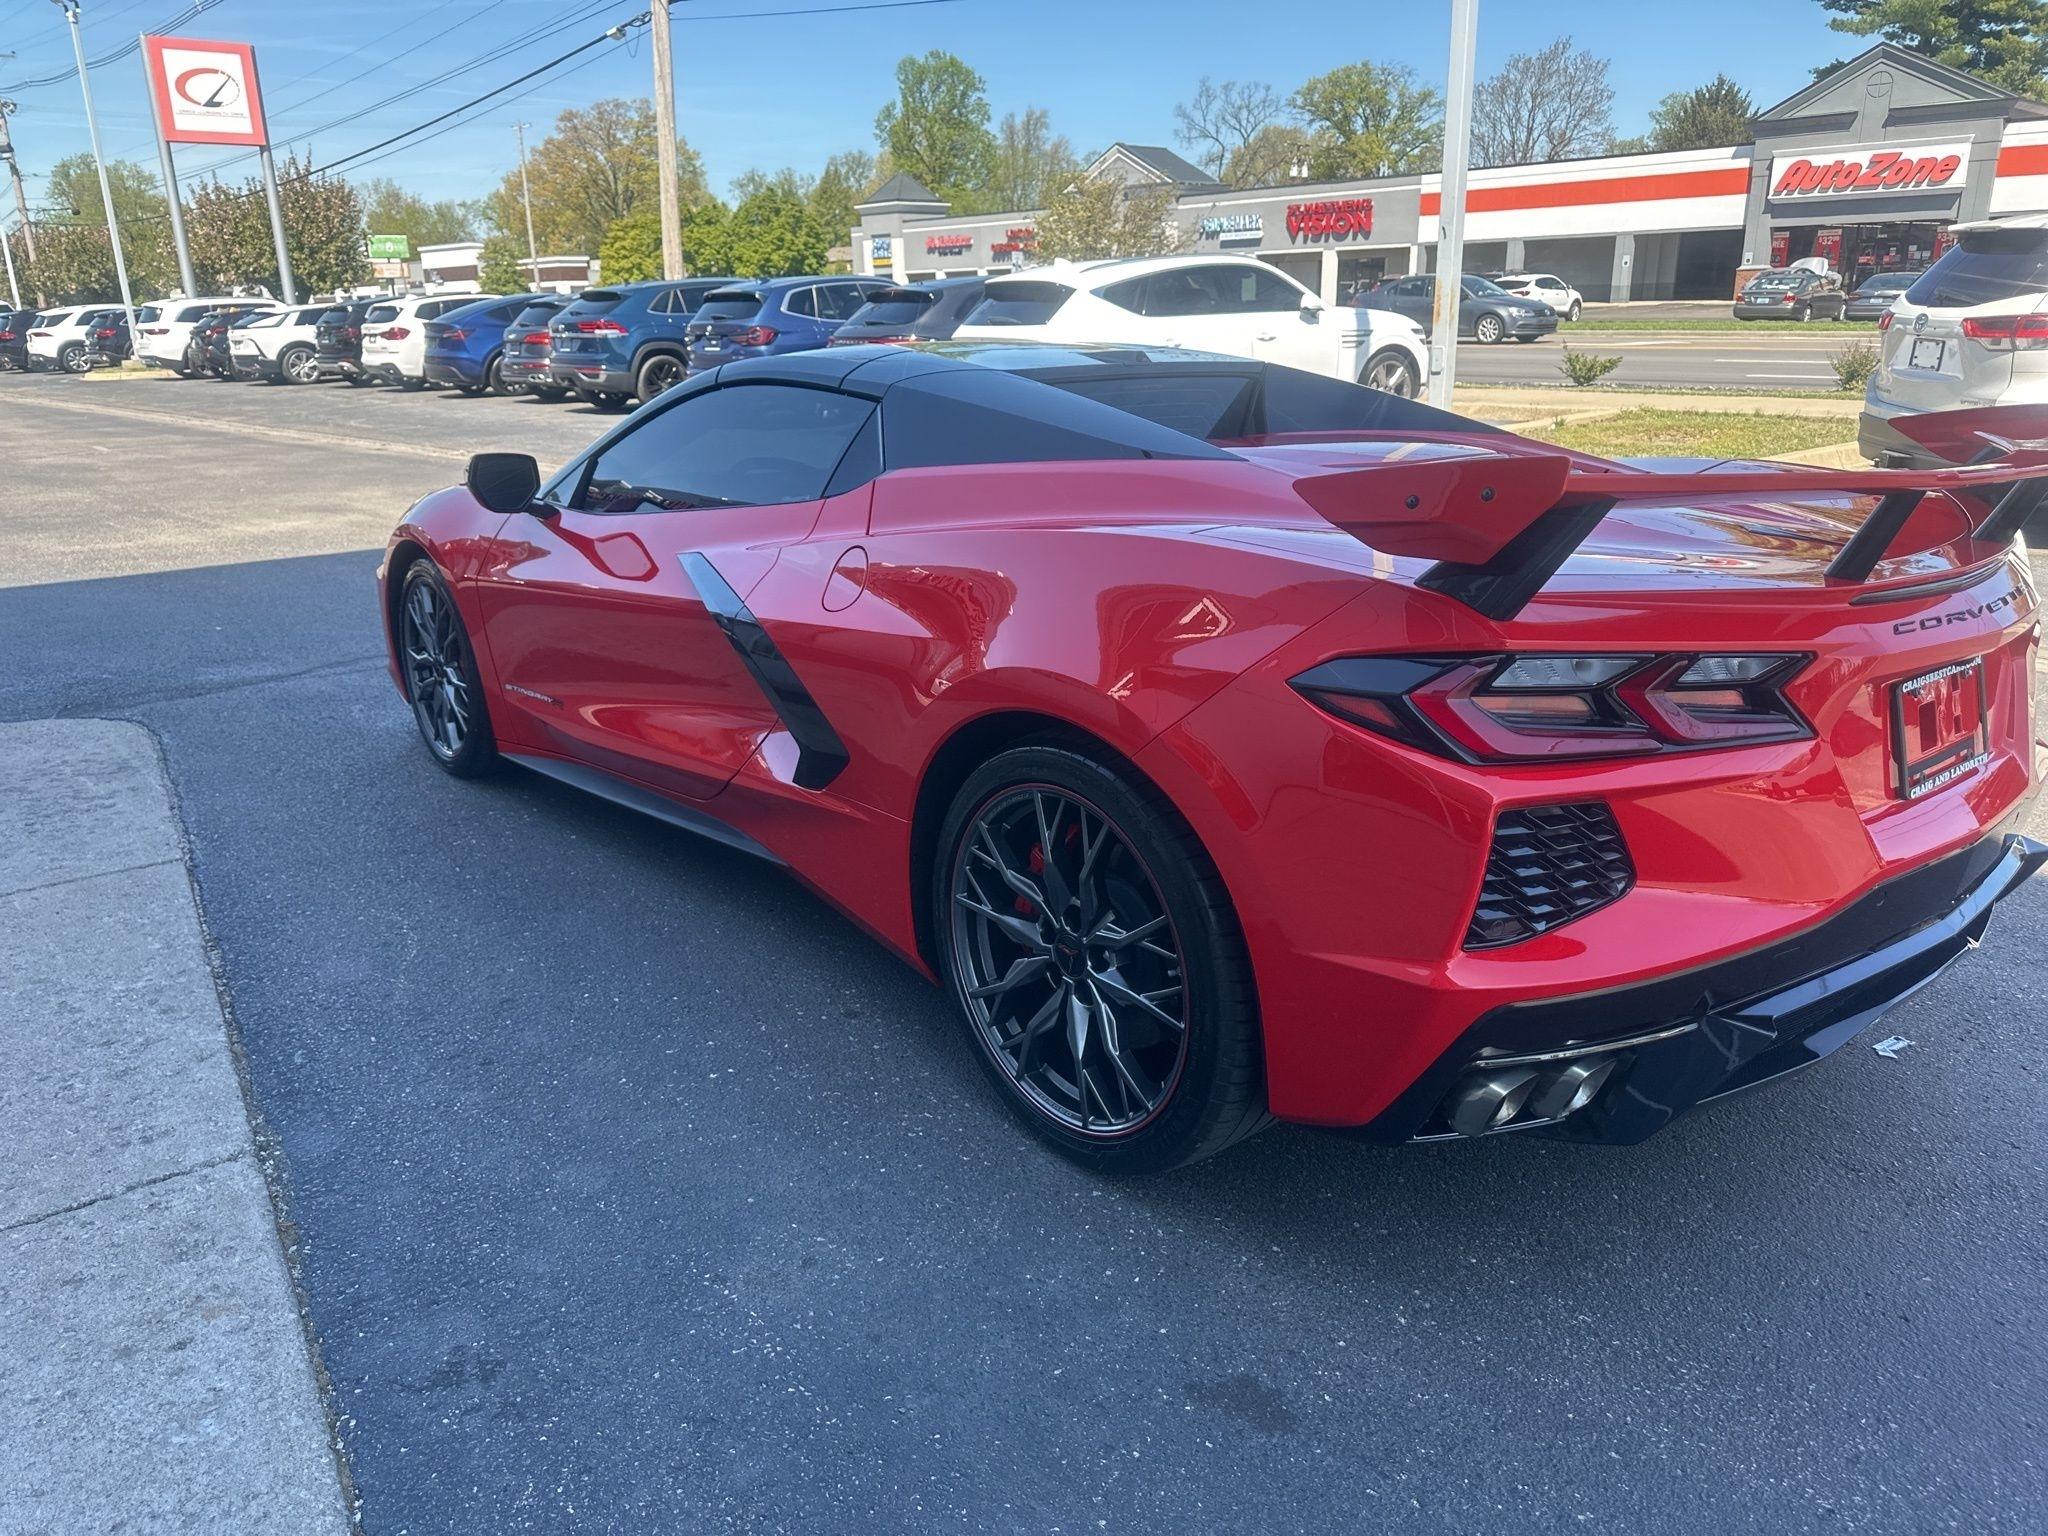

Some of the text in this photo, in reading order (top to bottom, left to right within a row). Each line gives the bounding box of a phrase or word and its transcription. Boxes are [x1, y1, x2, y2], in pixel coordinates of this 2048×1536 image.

[1773, 152, 1961, 196] AutoZone
[1286, 211, 1373, 243] VISION
[504, 683, 553, 703] STINGRAY
[1910, 752, 1988, 799] CRAIG AND LANDRETH
